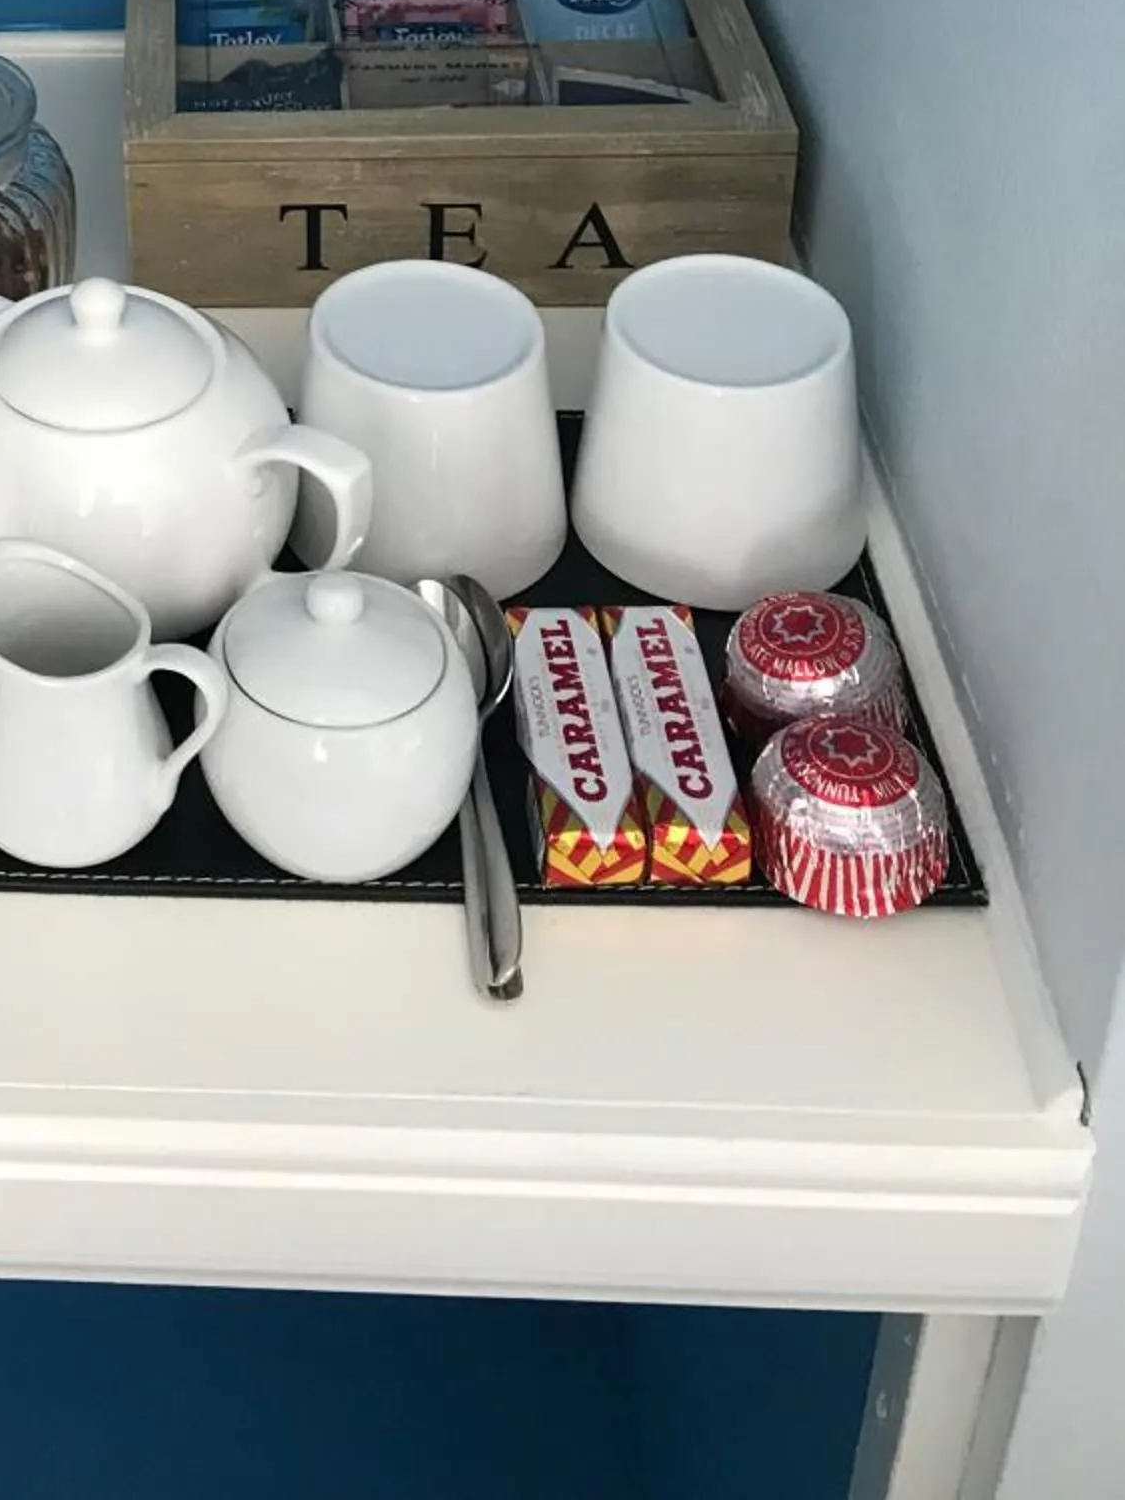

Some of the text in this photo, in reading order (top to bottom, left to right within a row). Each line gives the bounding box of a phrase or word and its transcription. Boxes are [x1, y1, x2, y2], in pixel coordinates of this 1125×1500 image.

[540, 619, 608, 802] CARAMEL
[636, 617, 713, 799] CARAMEL
[773, 655, 843, 678] MALLOW
